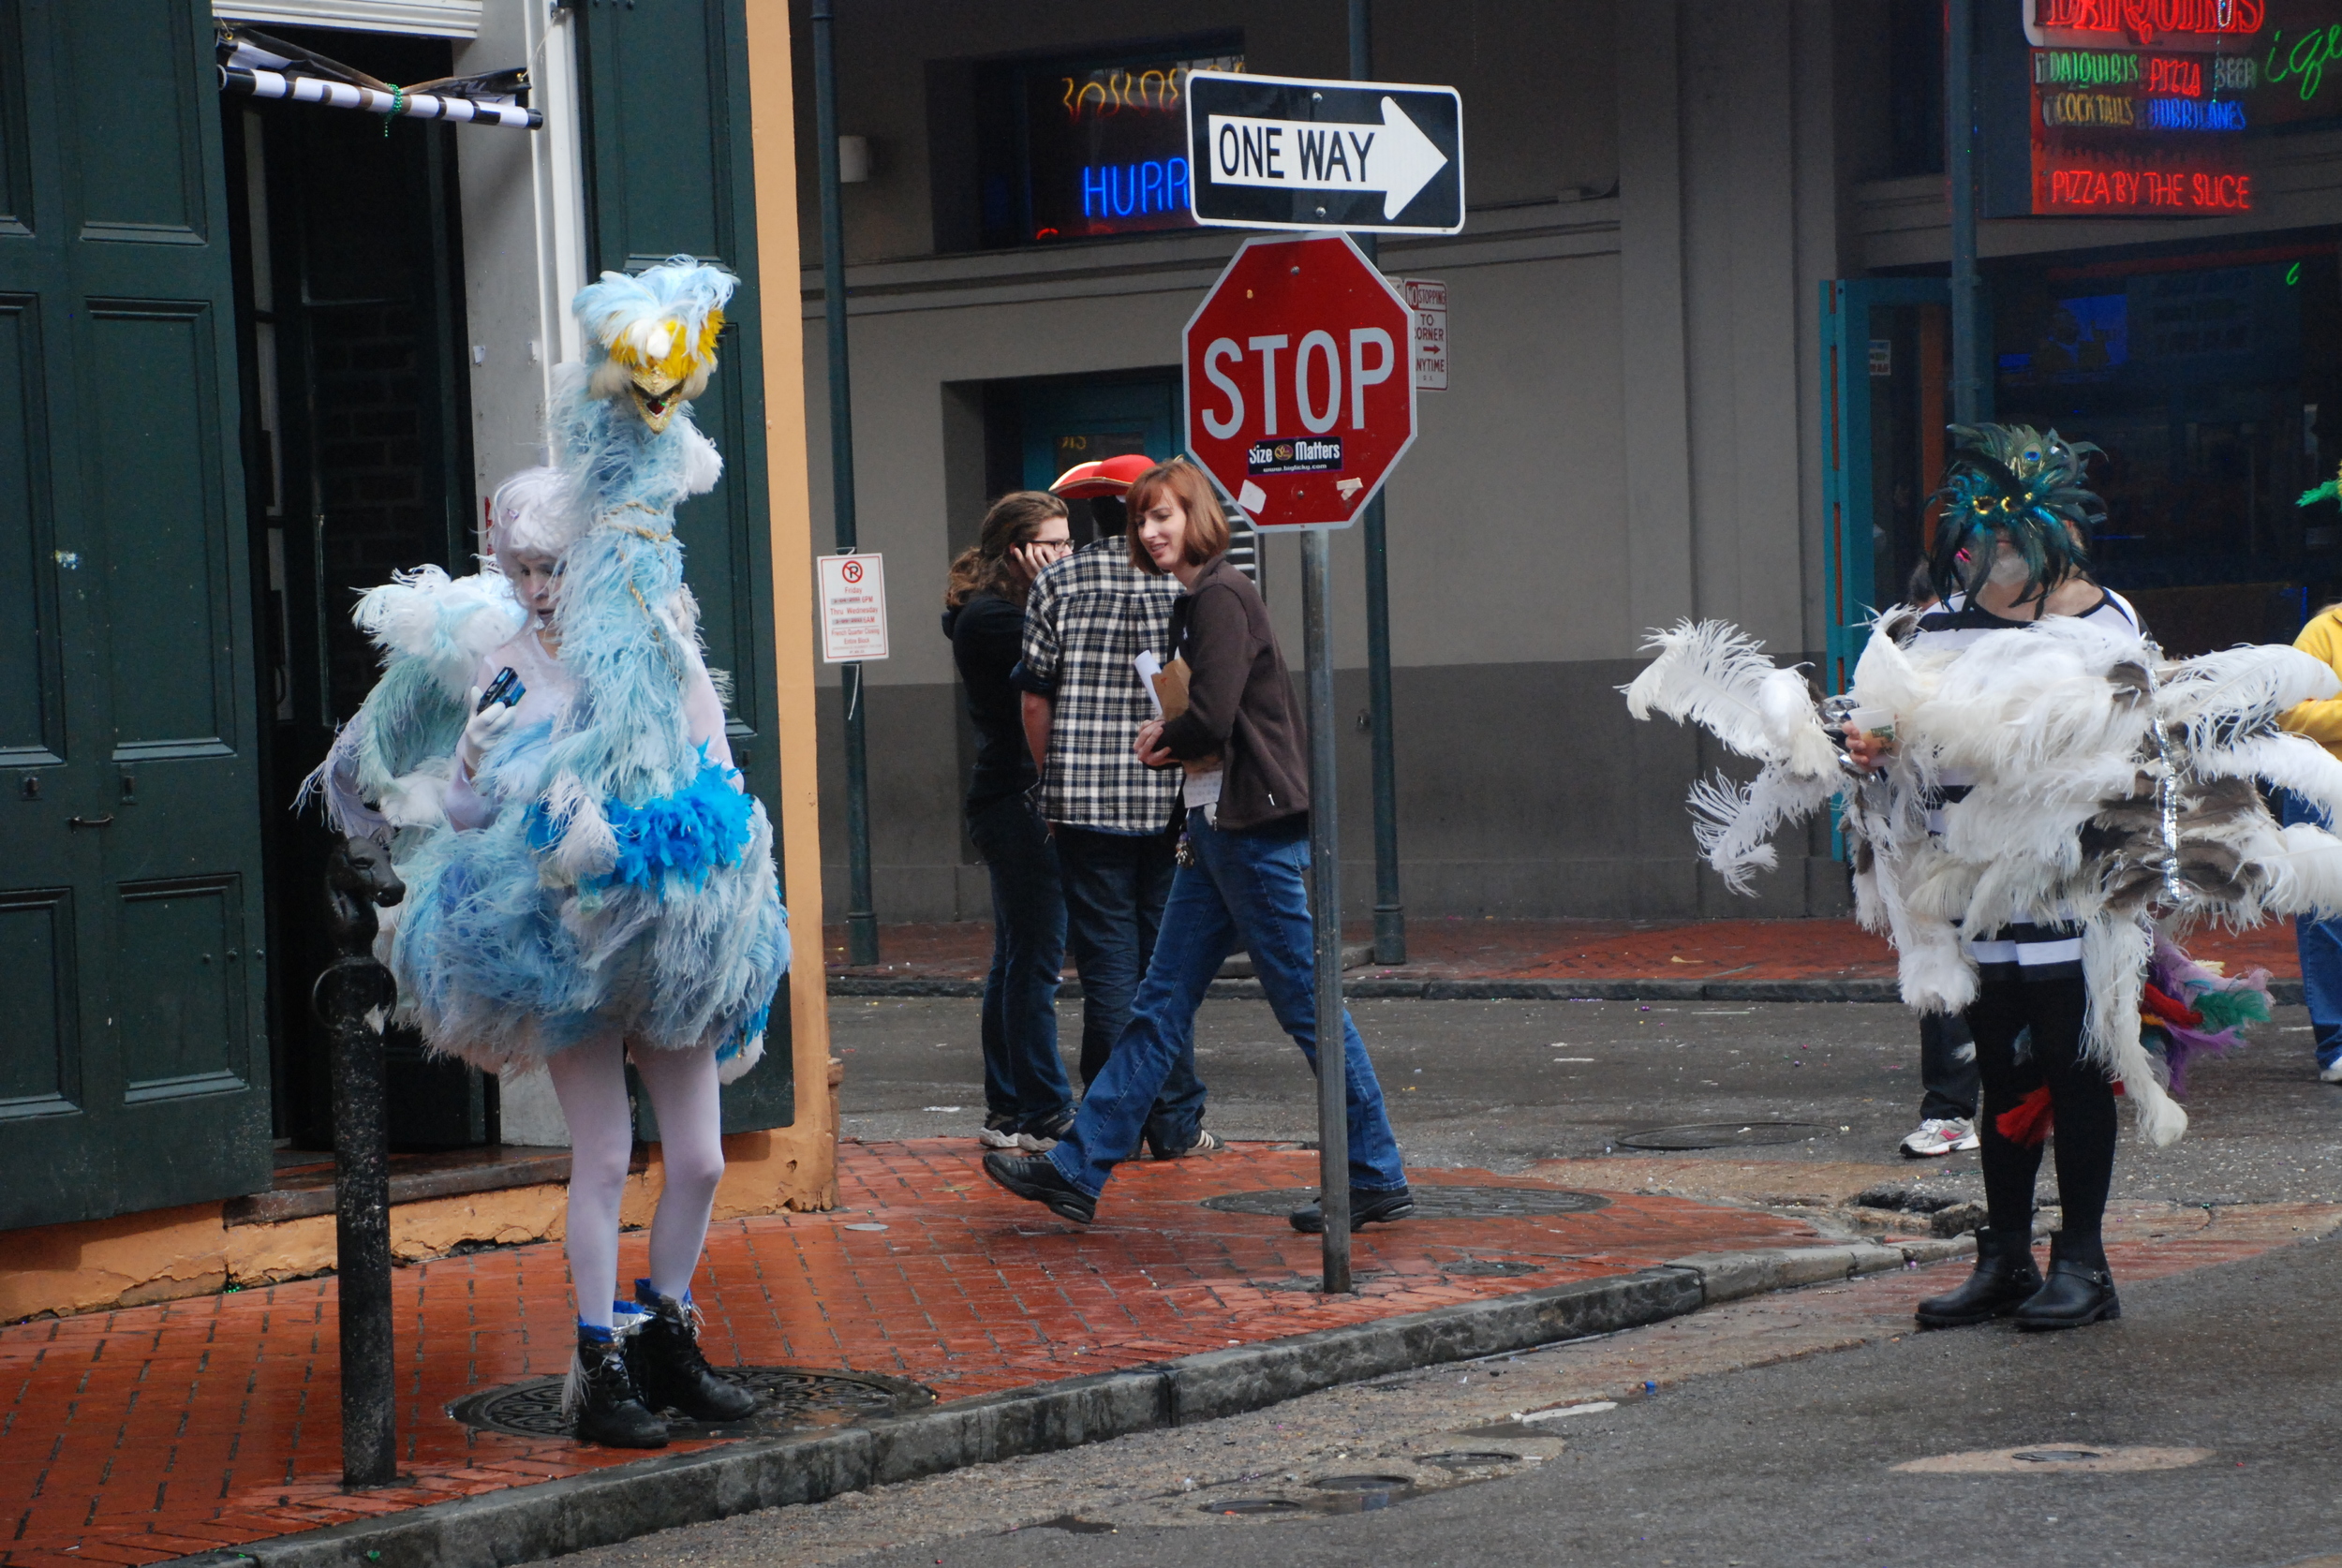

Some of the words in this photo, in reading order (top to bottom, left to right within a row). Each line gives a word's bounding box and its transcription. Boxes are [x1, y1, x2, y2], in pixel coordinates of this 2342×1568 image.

[2050, 52, 2140, 88] DAIQUIRIS
[2147, 58, 2201, 96] PIZZA
[2216, 57, 2257, 89] BEER
[2056, 92, 2135, 126] COCKTAILS
[1220, 123, 1284, 179] ONE
[1297, 128, 1375, 183] WAY
[2052, 170, 2111, 204] PIZZA
[2112, 170, 2140, 204] BY
[2143, 171, 2185, 206] THE
[2190, 173, 2251, 209] SLICE
[1406, 286, 1417, 306] NO
[1418, 288, 1445, 305] STOPPING
[1420, 314, 1434, 326] TO
[1415, 327, 1445, 341] ORNER
[1416, 358, 1445, 373] NYTIME
[1202, 327, 1395, 439] STOP
[1249, 444, 1273, 465] Size
[1295, 440, 1341, 461] Matters
[848, 628, 865, 636] Quarter
